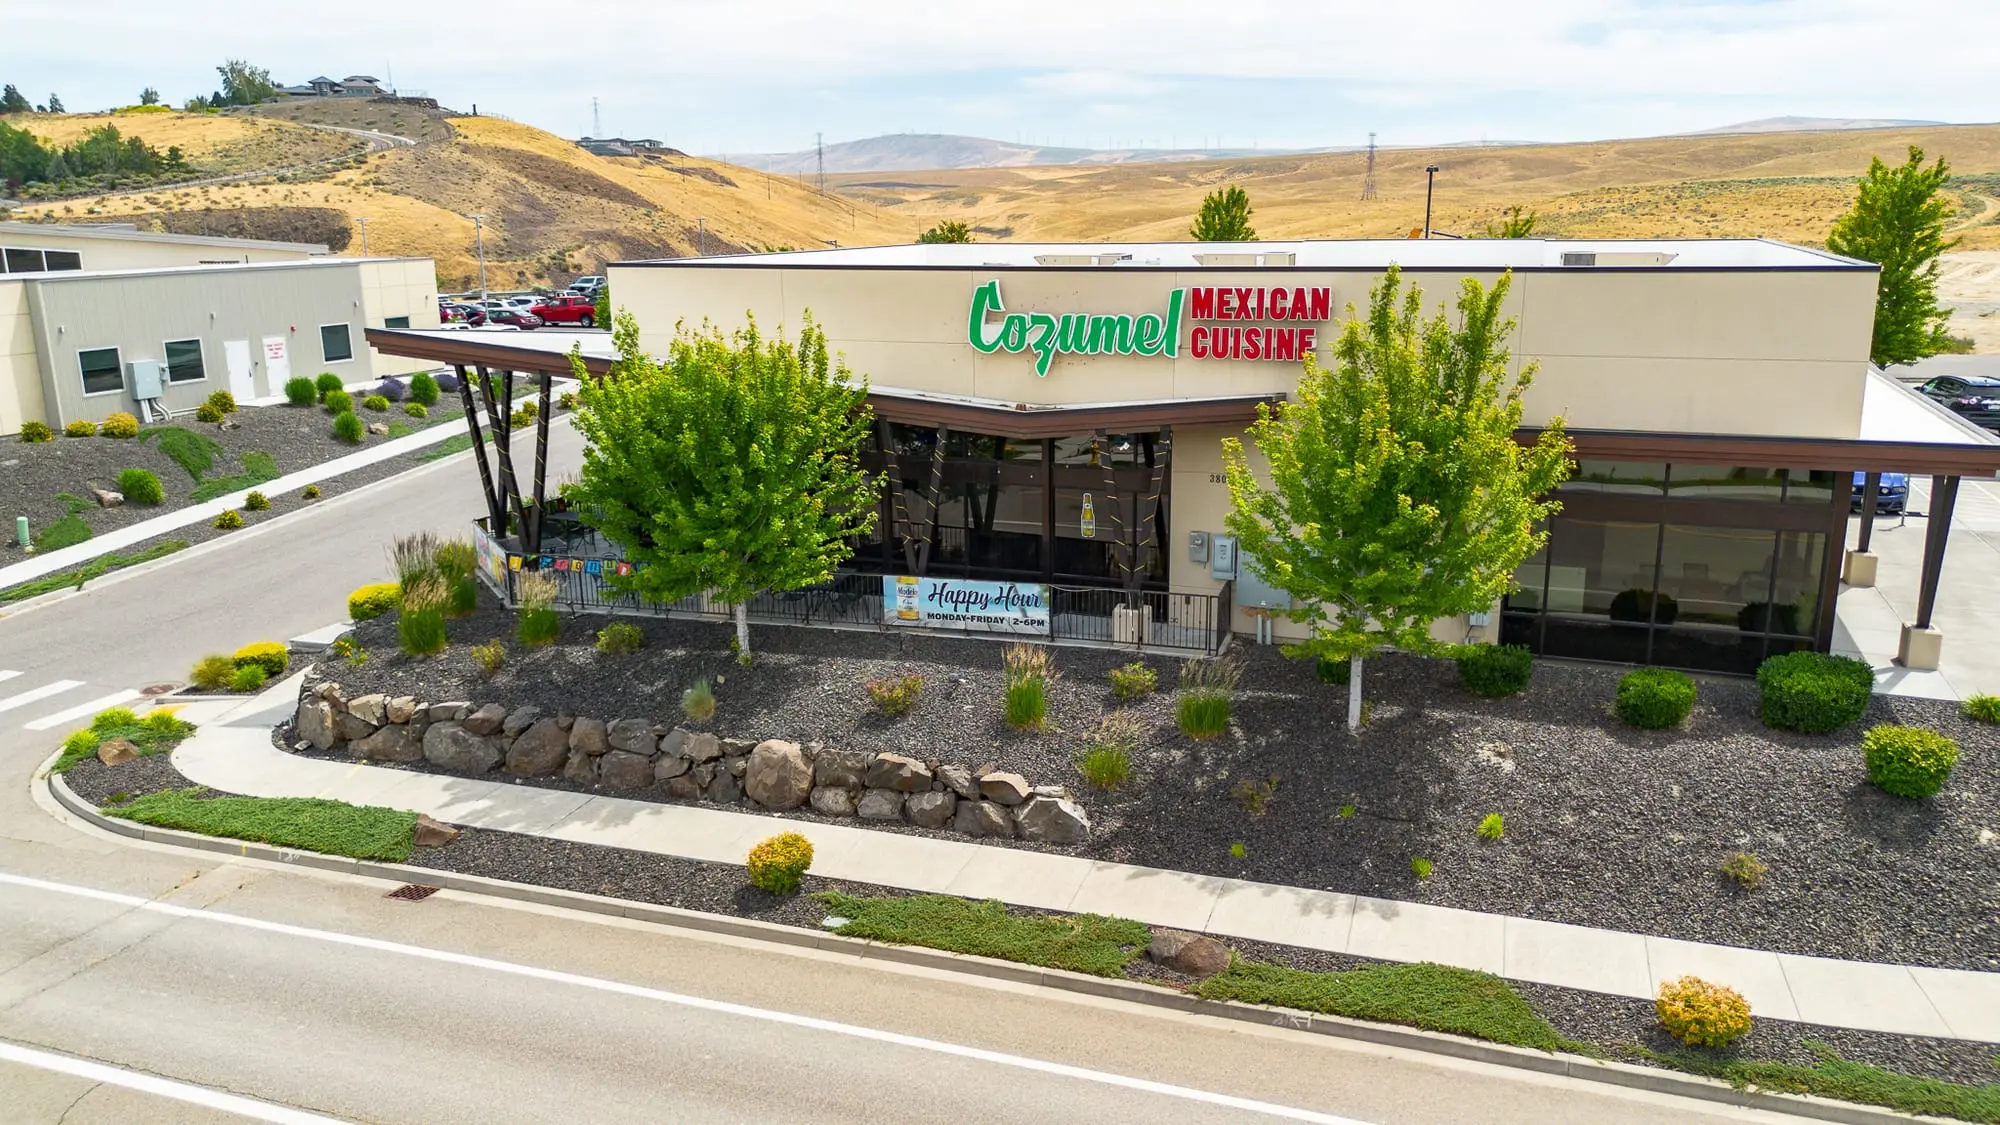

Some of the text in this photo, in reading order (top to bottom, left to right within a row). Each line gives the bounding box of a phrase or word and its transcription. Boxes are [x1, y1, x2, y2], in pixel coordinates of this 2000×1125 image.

[1190, 287, 1331, 321] MEXICAN
[968, 279, 1185, 377] Cozumel
[1190, 327, 1317, 361] CUISINE
[928, 582, 1042, 612] Happy Hour
[927, 612, 1045, 627] MONDAY-FRIDAY 2-6PM
